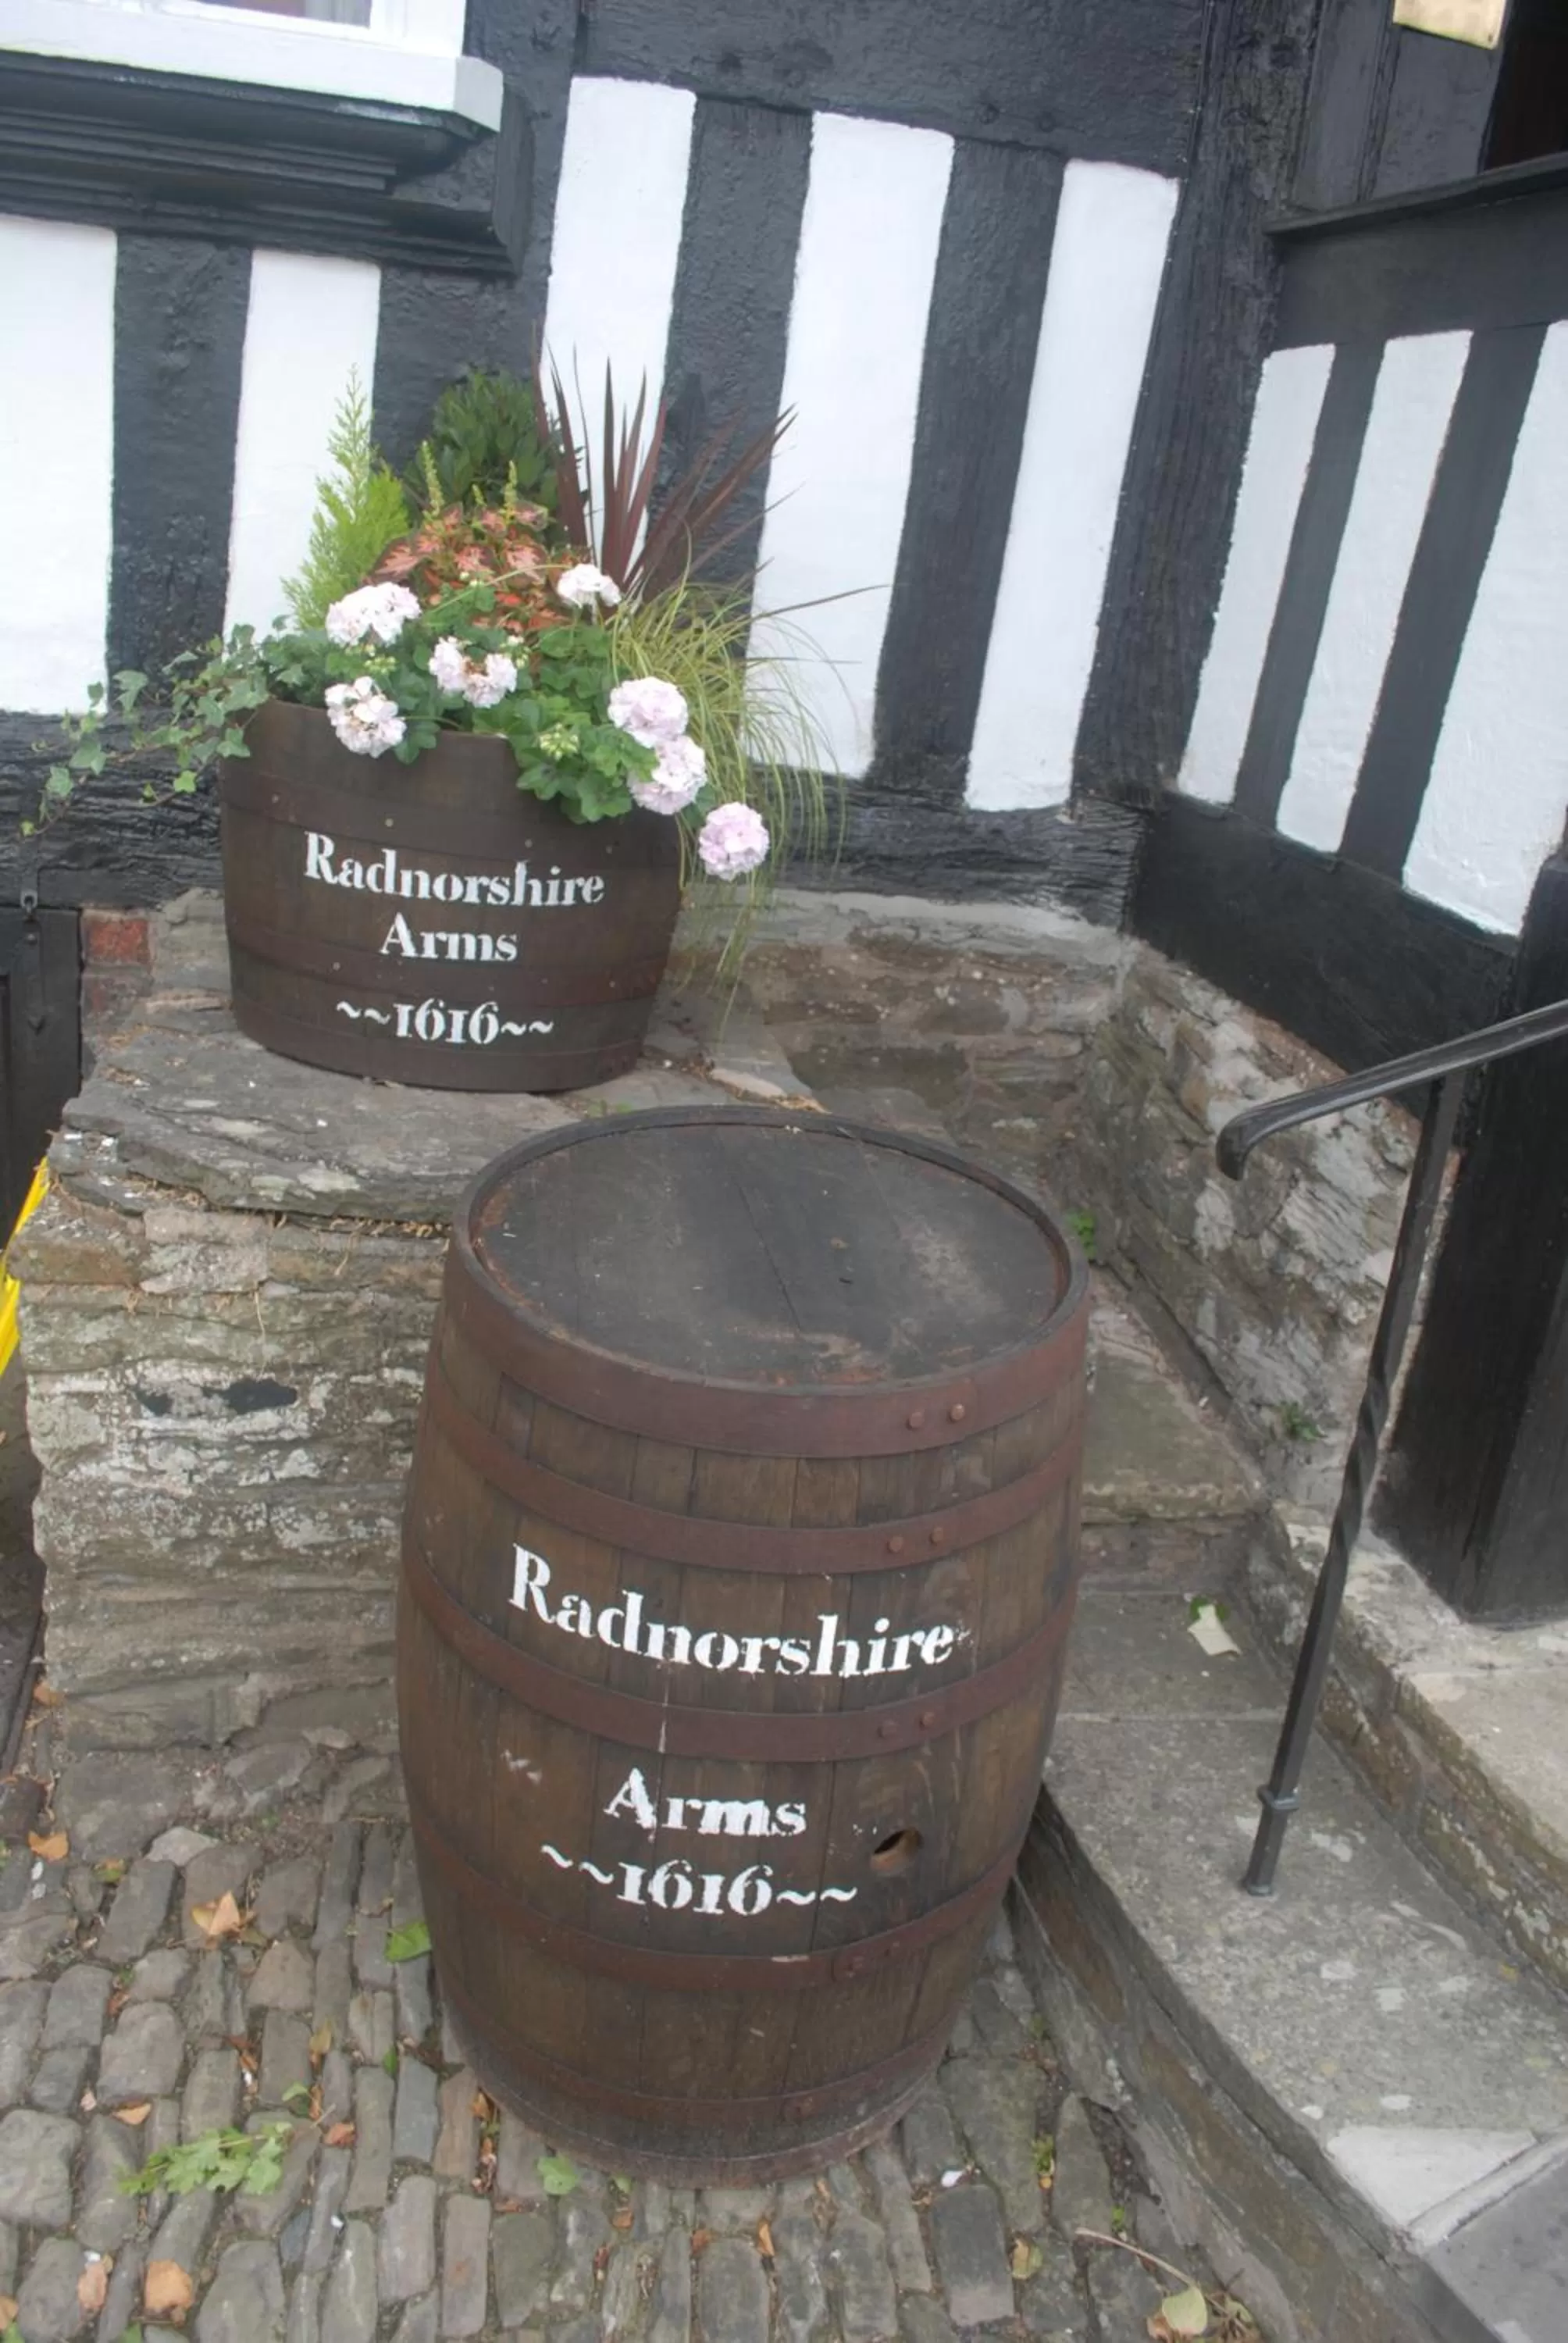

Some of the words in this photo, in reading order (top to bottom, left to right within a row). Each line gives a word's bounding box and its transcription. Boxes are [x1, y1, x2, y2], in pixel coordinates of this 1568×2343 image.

[304, 831, 604, 907] Radnorshire
[380, 911, 518, 961] Arms
[508, 1542, 955, 1679] Radnorshire
[603, 1767, 807, 1838] Arms
